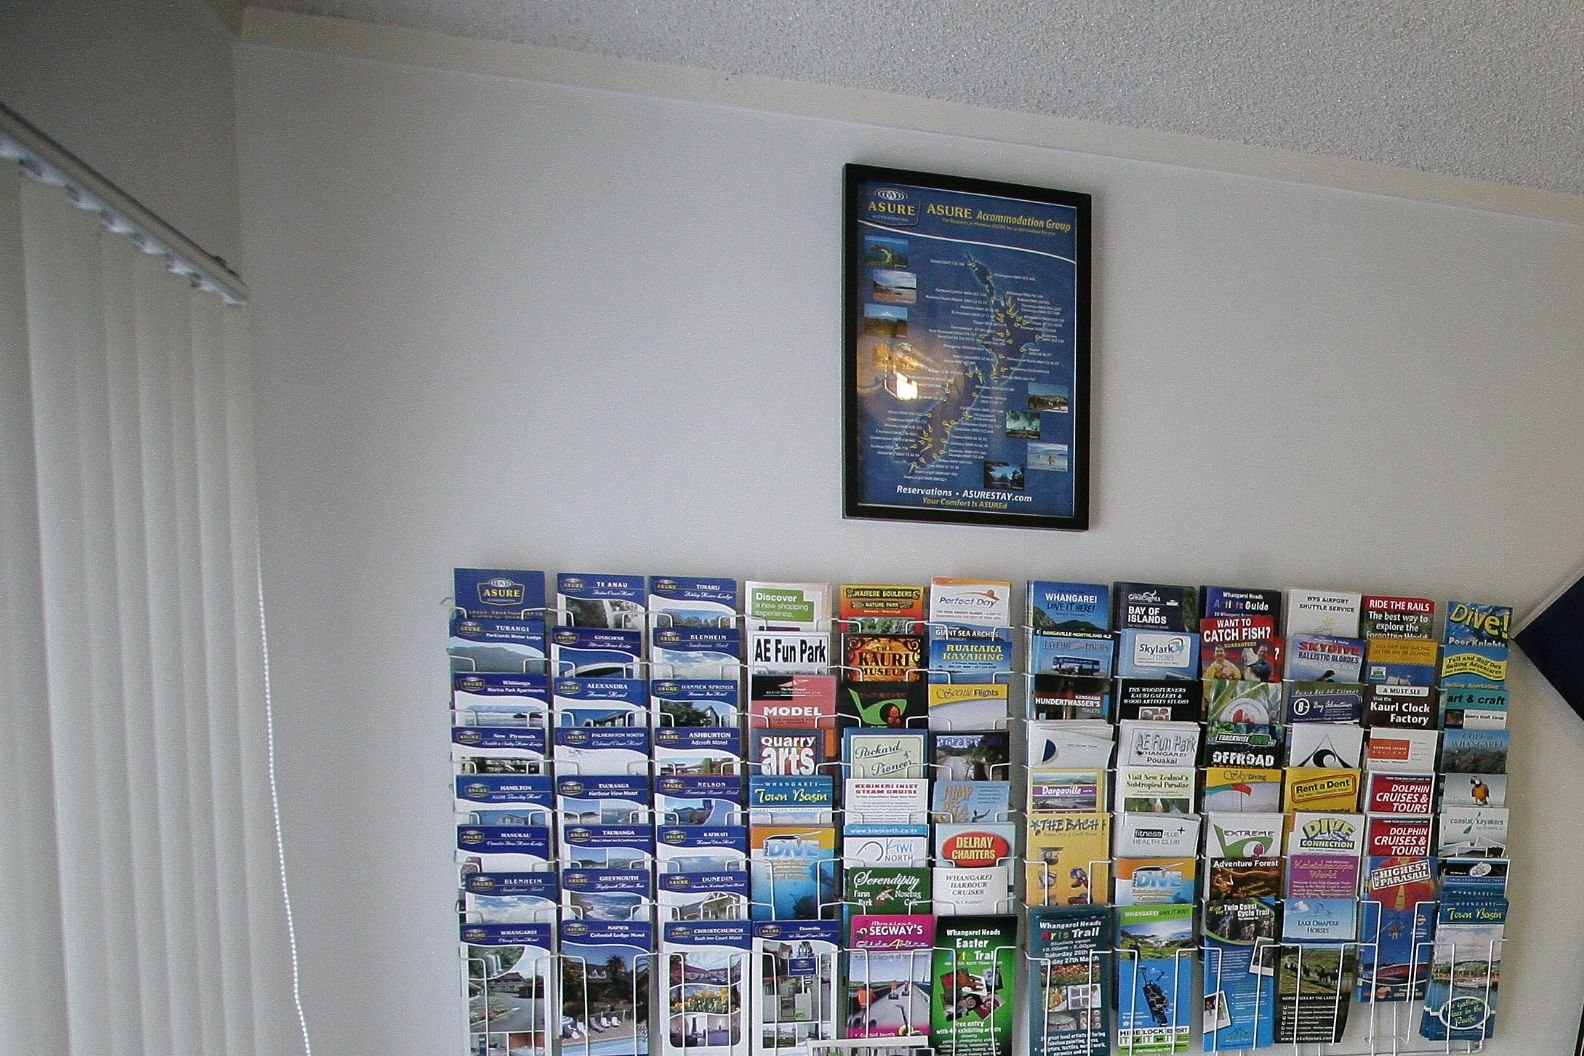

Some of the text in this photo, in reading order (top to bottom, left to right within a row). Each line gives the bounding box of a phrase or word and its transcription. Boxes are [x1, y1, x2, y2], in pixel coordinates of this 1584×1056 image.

[868, 201, 915, 217] ASURE
[927, 204, 972, 219] ASURE
[977, 210, 1045, 229] Accommodation
[1045, 218, 1071, 233] Group
[897, 485, 1032, 502] Reservations ASURESTAY.com
[940, 499, 970, 507] Comfort
[484, 589, 520, 598] ASURE
[755, 592, 797, 602] Discover
[1046, 593, 1097, 603] WHANGAREI
[939, 597, 996, 608] Perfect Day
[1245, 601, 1269, 611] Guide
[1370, 600, 1429, 611] RIDE THE RAILS
[1129, 606, 1160, 615] BAY OF
[1128, 615, 1167, 624] ISLANDS
[1369, 611, 1380, 620] The
[1382, 612, 1400, 621] best
[1402, 613, 1418, 623] way
[1450, 604, 1510, 638] Dive!
[1217, 619, 1239, 628] WANT
[1376, 622, 1419, 632] explore the
[1204, 627, 1271, 642] CATCH FISH?
[755, 638, 771, 662] AE
[774, 640, 797, 663] Fun
[800, 640, 826, 663] Park
[1139, 644, 1174, 655] Skylark
[1298, 641, 1360, 655] SKYDIVE
[858, 653, 910, 666] KAURI
[943, 653, 1004, 661] KAYAKING
[1299, 652, 1330, 661] BALLISTIC
[1036, 698, 1100, 707] HUNDERTWASSER'S
[1447, 694, 1505, 705] art & craft
[764, 706, 822, 716] MODEL
[1370, 702, 1429, 712] Kauri Clock
[1390, 714, 1428, 725] Factory
[760, 736, 815, 749] Quarry
[855, 741, 901, 759] Packard
[760, 747, 814, 776] arts
[1213, 751, 1274, 767] OFFROAD
[871, 761, 912, 776] Pioneer
[1042, 786, 1082, 795] Dargaville
[1296, 784, 1317, 794] Rent
[1326, 780, 1350, 789] Dent
[1391, 785, 1429, 793] DOLPHIN
[755, 788, 827, 802] Town Basin
[1377, 793, 1428, 802] CRUISES &
[1392, 803, 1428, 813] TOURS
[1040, 818, 1099, 832] THE BACH
[1303, 818, 1356, 837] DIVE
[1134, 830, 1162, 838] fitness
[956, 837, 993, 849] DELRAY
[1302, 840, 1353, 848] CONNECTION
[1374, 836, 1427, 845] CRUISES &
[952, 849, 996, 860] CHARTERS
[1391, 846, 1425, 855] TOURS
[1310, 870, 1337, 879] World
[1380, 863, 1428, 878] HIGHEST
[854, 870, 920, 890] Serendipity
[1380, 871, 1429, 886] PARASAIL
[1448, 907, 1502, 920] Town Basin
[870, 925, 923, 935] SEGWAY'S
[1039, 921, 1079, 929] Whangarei
[1072, 928, 1099, 937] Trail
[956, 938, 989, 948] Easter
